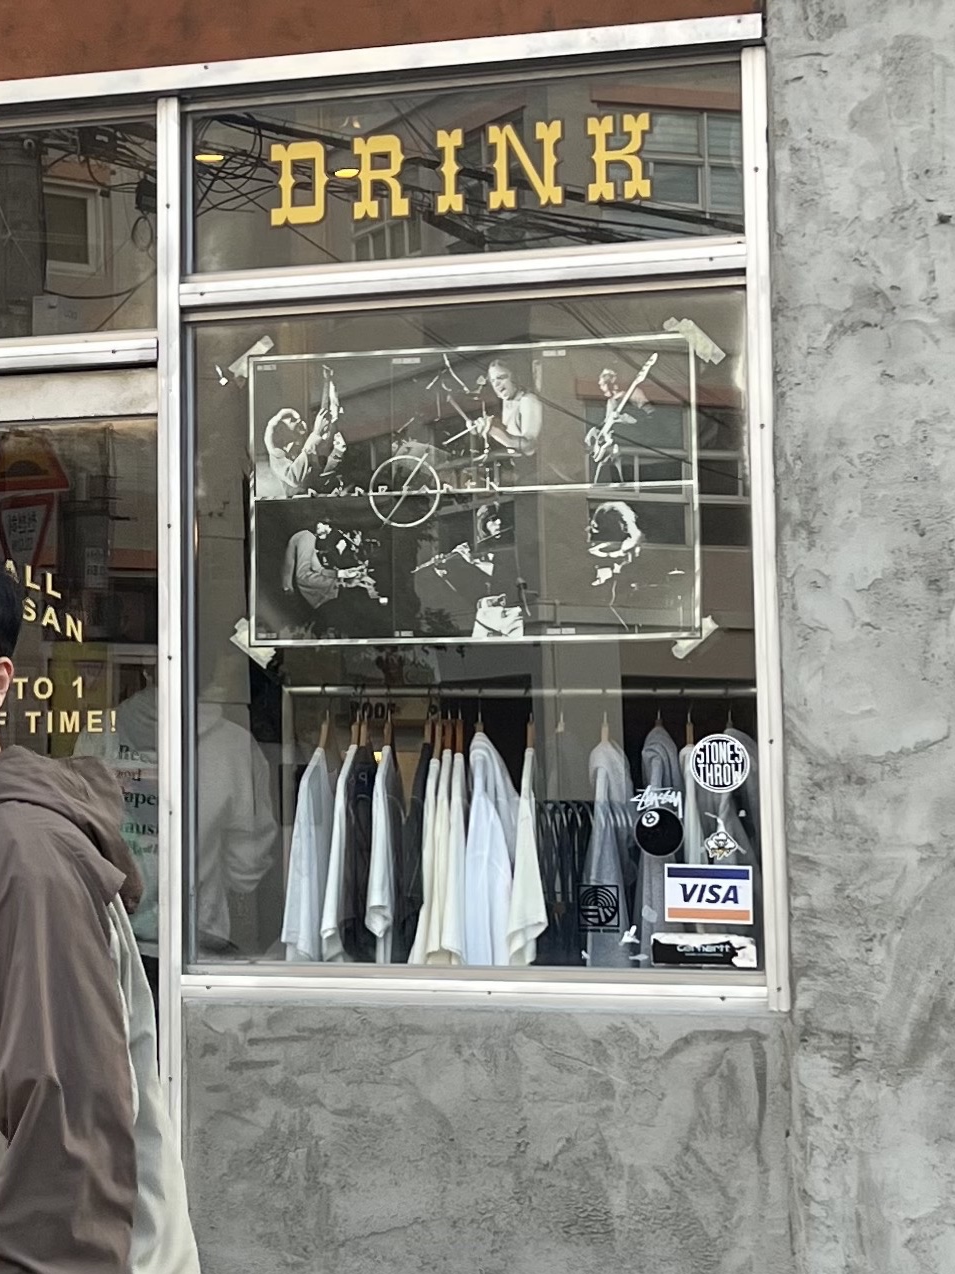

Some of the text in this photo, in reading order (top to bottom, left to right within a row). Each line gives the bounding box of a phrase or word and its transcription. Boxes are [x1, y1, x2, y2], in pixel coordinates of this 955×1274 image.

[269, 111, 652, 227] DRINK
[22, 597, 84, 644] SAN
[12, 676, 84, 700] TO 1
[24, 710, 117, 734] TIME!
[696, 741, 743, 764] STONES
[697, 763, 742, 786] THROW
[679, 882, 740, 905] VISA
